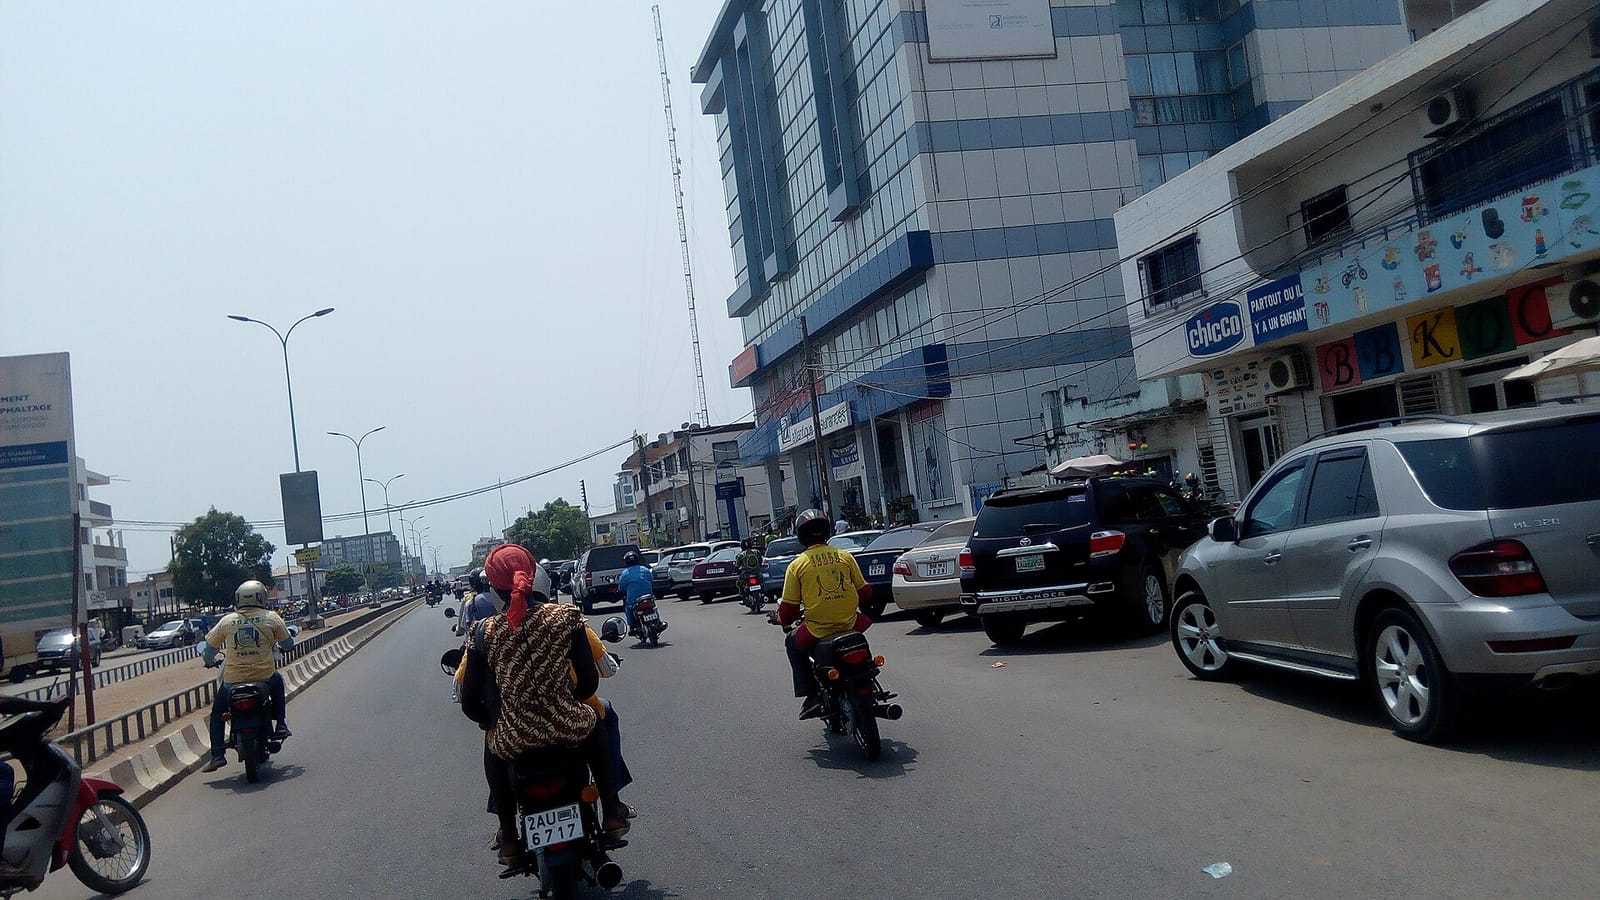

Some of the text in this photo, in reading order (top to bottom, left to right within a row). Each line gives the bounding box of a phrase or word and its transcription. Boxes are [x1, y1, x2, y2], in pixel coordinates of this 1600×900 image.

[1250, 292, 1281, 313] PARTOUT
[1284, 286, 1295, 301] OU
[1188, 311, 1241, 349] chicco
[1254, 306, 1307, 335] Y A UN ENFANT
[1513, 521, 1530, 529] ML
[992, 591, 1066, 603] HIGHLANDER
[527, 811, 556, 831] 2AU
[532, 823, 576, 846] 6717
